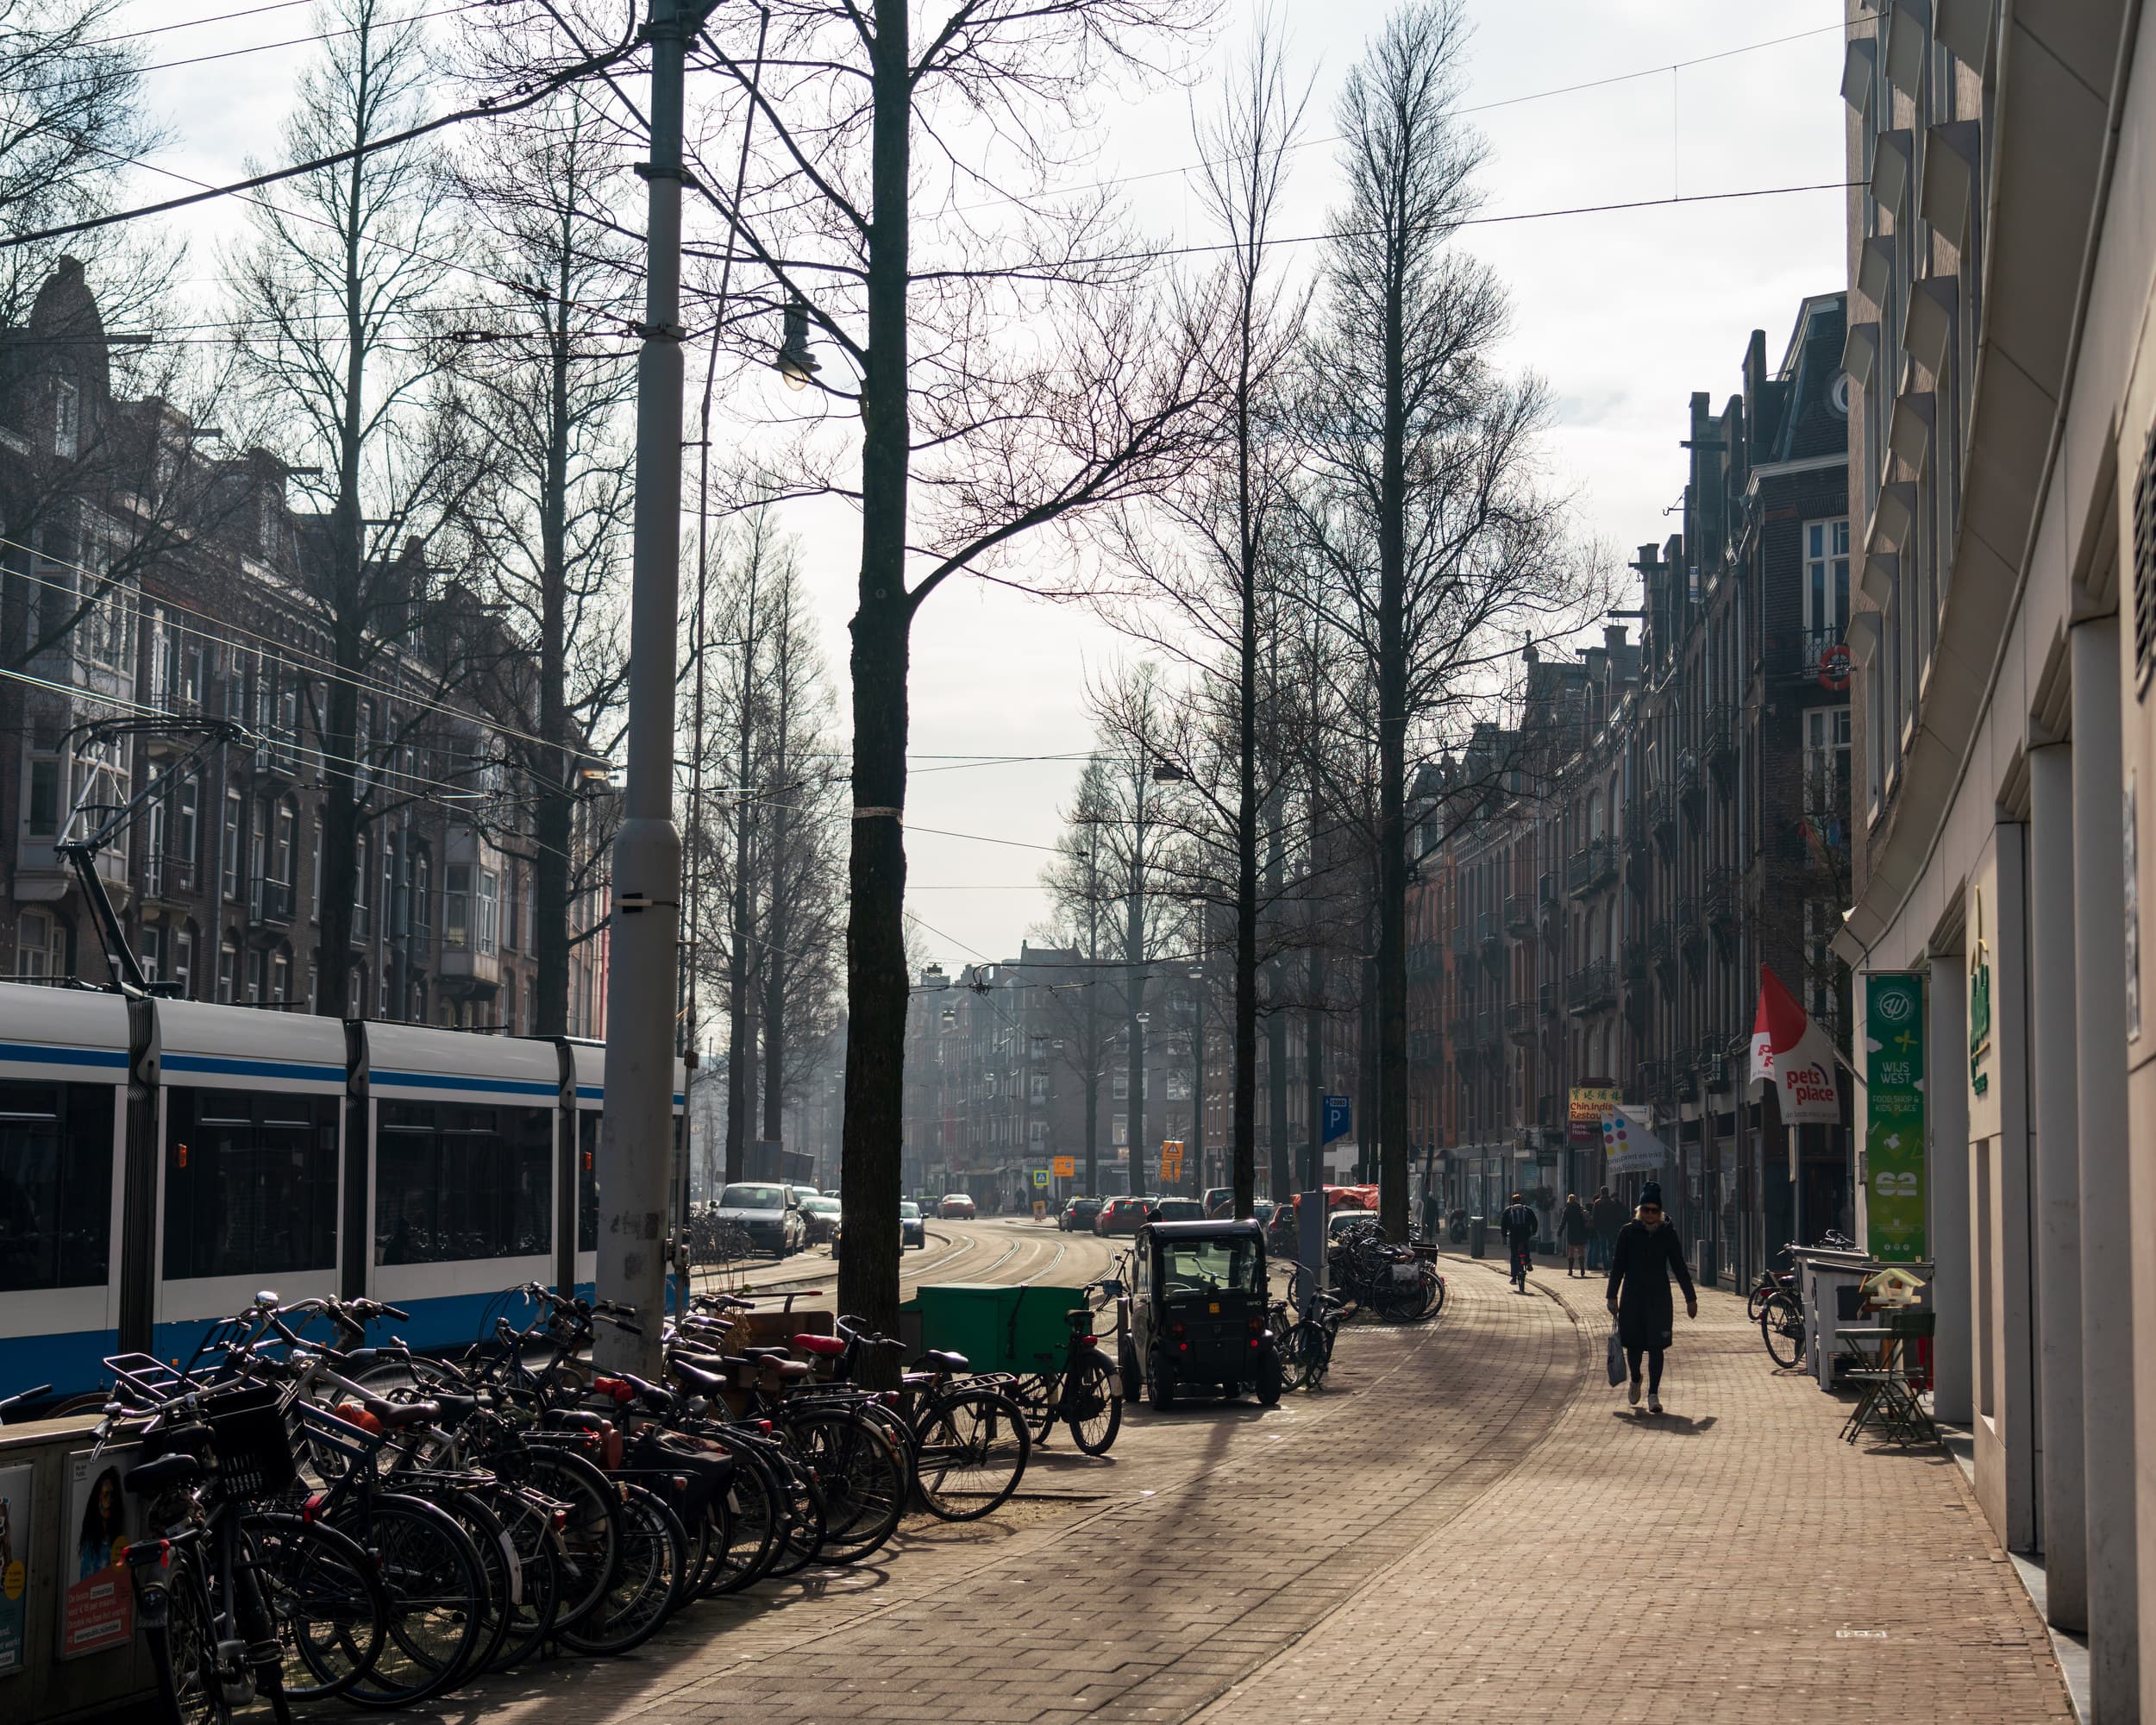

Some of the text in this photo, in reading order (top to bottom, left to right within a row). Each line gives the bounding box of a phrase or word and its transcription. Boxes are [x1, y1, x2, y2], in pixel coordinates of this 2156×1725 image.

[1882, 1062, 1910, 1073] WIJS
[1786, 1069, 1821, 1089] pets
[1880, 1073, 1911, 1084] WEST
[1796, 1085, 1834, 1105] place
[1331, 1109, 1341, 1128] P
[1570, 1110, 1601, 1120] Restau
